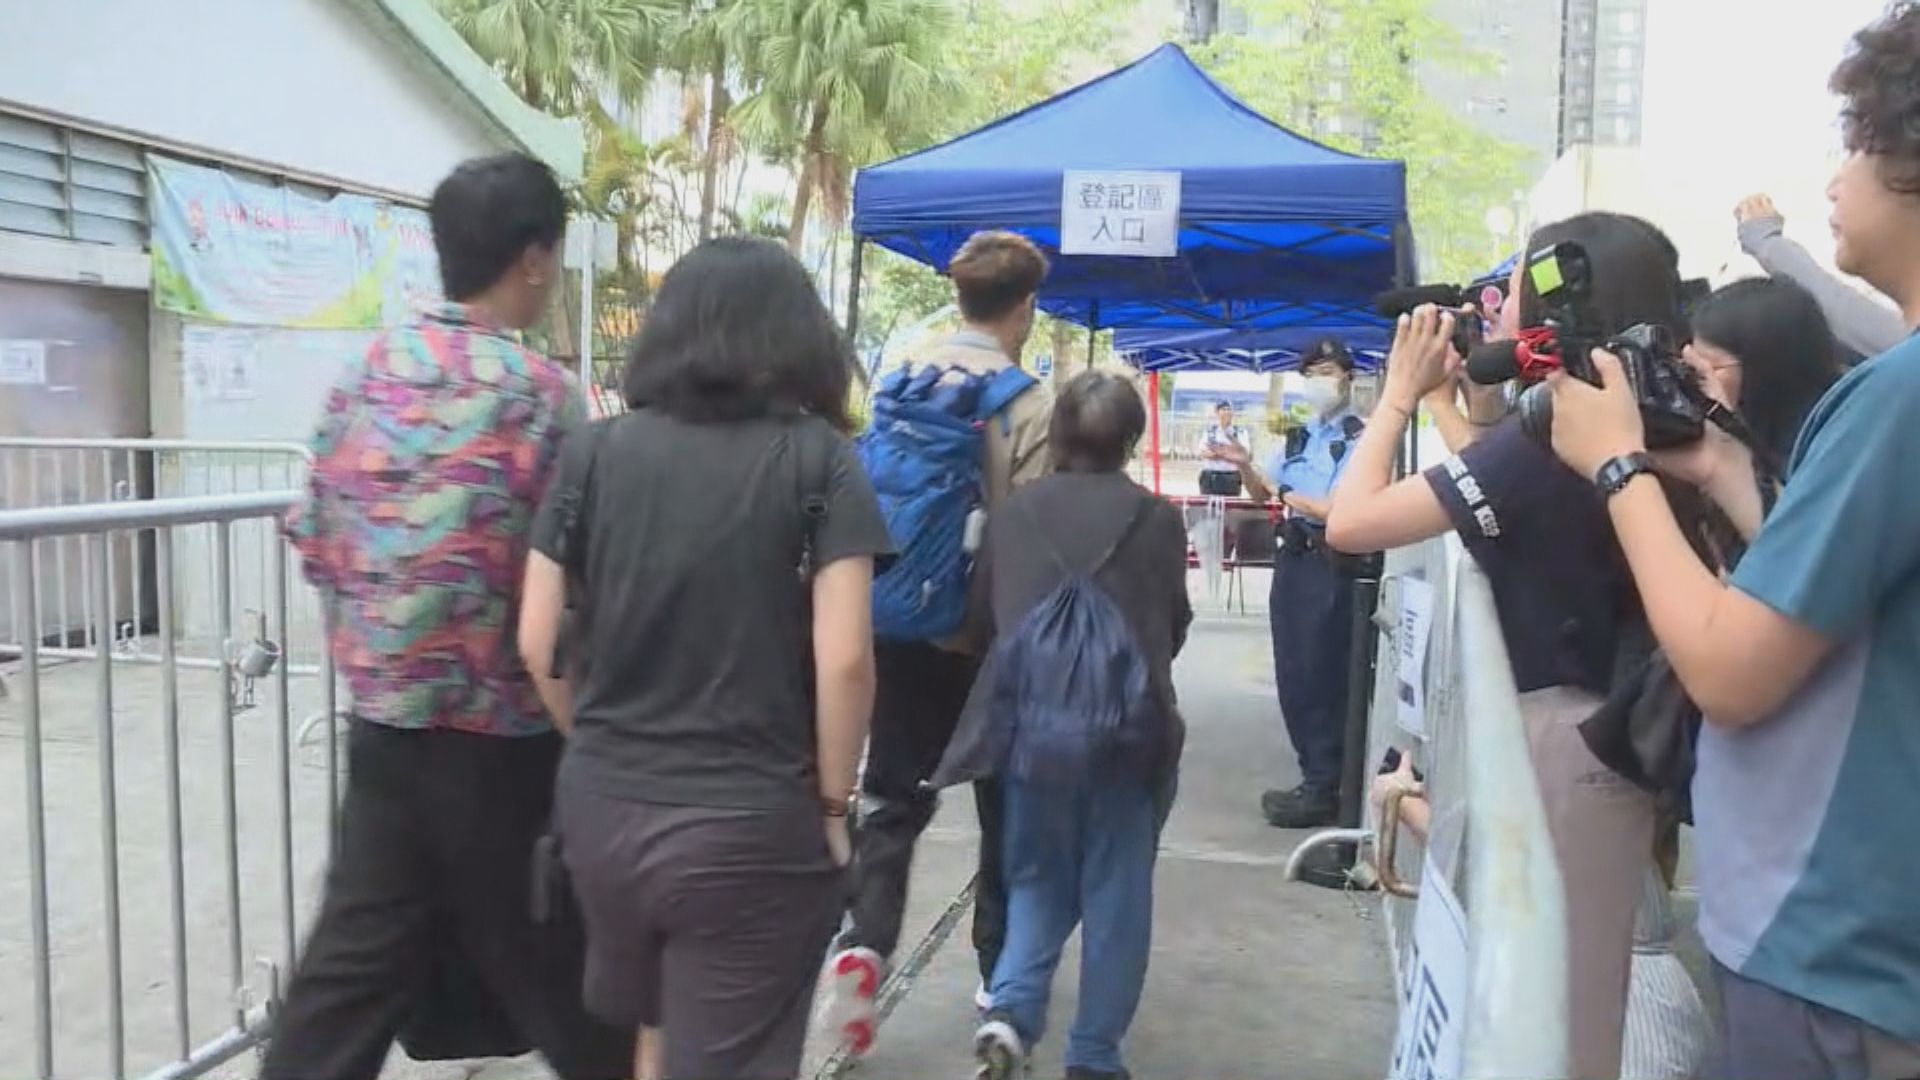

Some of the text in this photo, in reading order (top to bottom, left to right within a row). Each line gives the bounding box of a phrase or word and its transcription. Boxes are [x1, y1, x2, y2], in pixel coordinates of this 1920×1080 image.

[1080, 182, 1164, 210] 登記區
[1092, 216, 1144, 242] 入口
